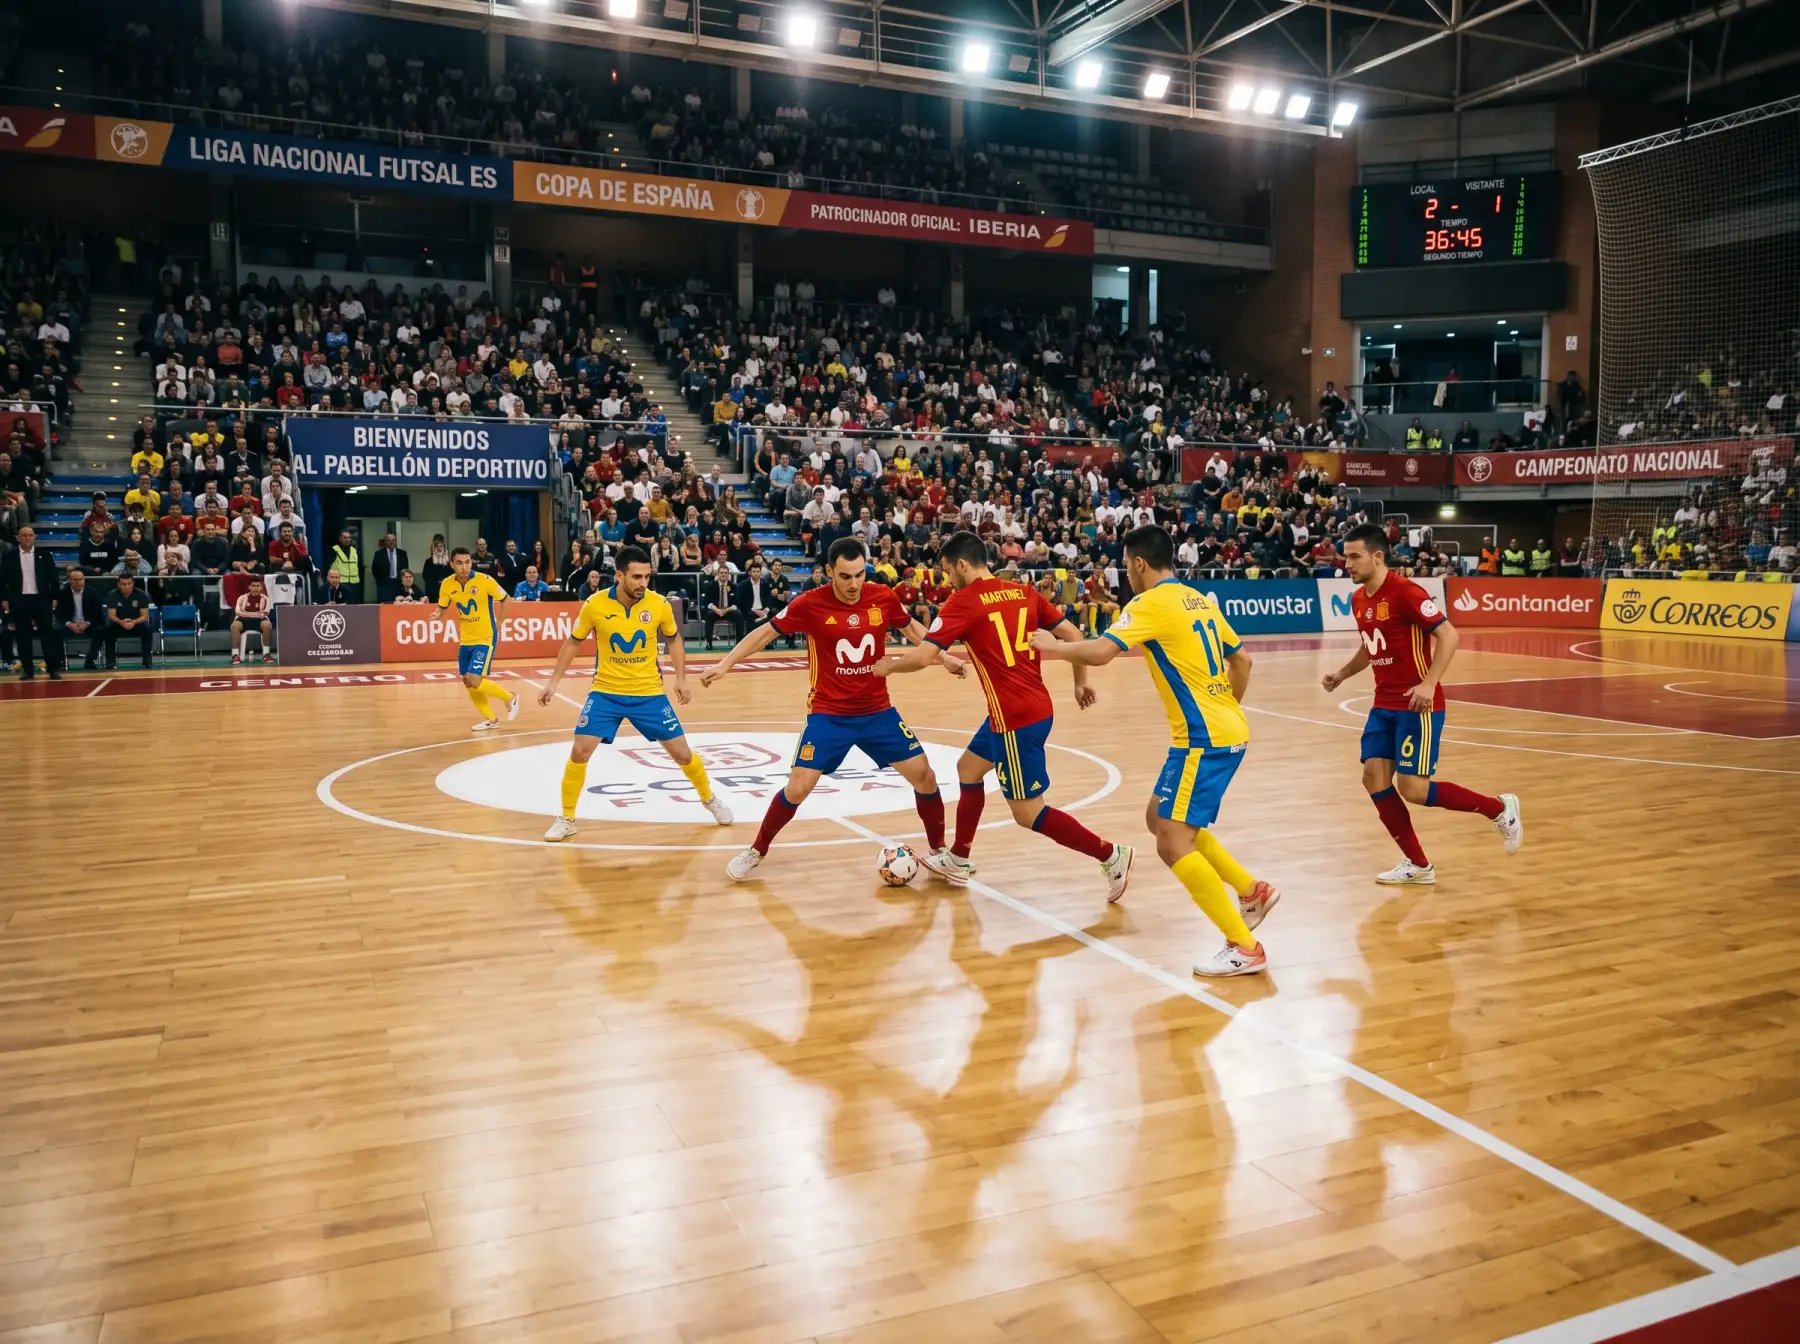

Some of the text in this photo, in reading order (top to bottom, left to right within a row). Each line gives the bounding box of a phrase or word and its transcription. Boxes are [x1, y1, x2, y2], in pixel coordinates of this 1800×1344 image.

[190, 136, 498, 189] LIGA NACIONAL FUTSAL ES
[536, 172, 715, 213] COPA DE ESPAÑA
[1411, 179, 1505, 195] LOCAL VISITANTE
[811, 204, 961, 233] PATROCINADOR OFICIAL:
[1425, 198, 1438, 219] 2
[1495, 194, 1502, 213] 1
[969, 218, 1041, 240] IBERIA
[1441, 218, 1467, 228] TIEMPO
[1425, 228, 1482, 251] 36:45
[1423, 250, 1483, 262] SEGUNDO TIEMPO
[354, 426, 490, 450] BIENVENIDOS
[293, 452, 548, 480] AL PABELLÓN DEPORTIVO
[1514, 453, 1629, 478] CAMPEONATO
[1633, 448, 1725, 471] NACIONAL
[1225, 597, 1314, 617] movistar
[1481, 592, 1594, 613] Santander
[1649, 596, 1780, 630] CORREOS
[396, 619, 460, 645] COPA
[988, 606, 1036, 668] 14
[1192, 619, 1225, 677] 11
[200, 674, 407, 688] CENTRO
[836, 665, 875, 675] movista
[898, 721, 915, 739] 8
[1401, 735, 1414, 758] 6
[609, 782, 951, 807] FUTSA
